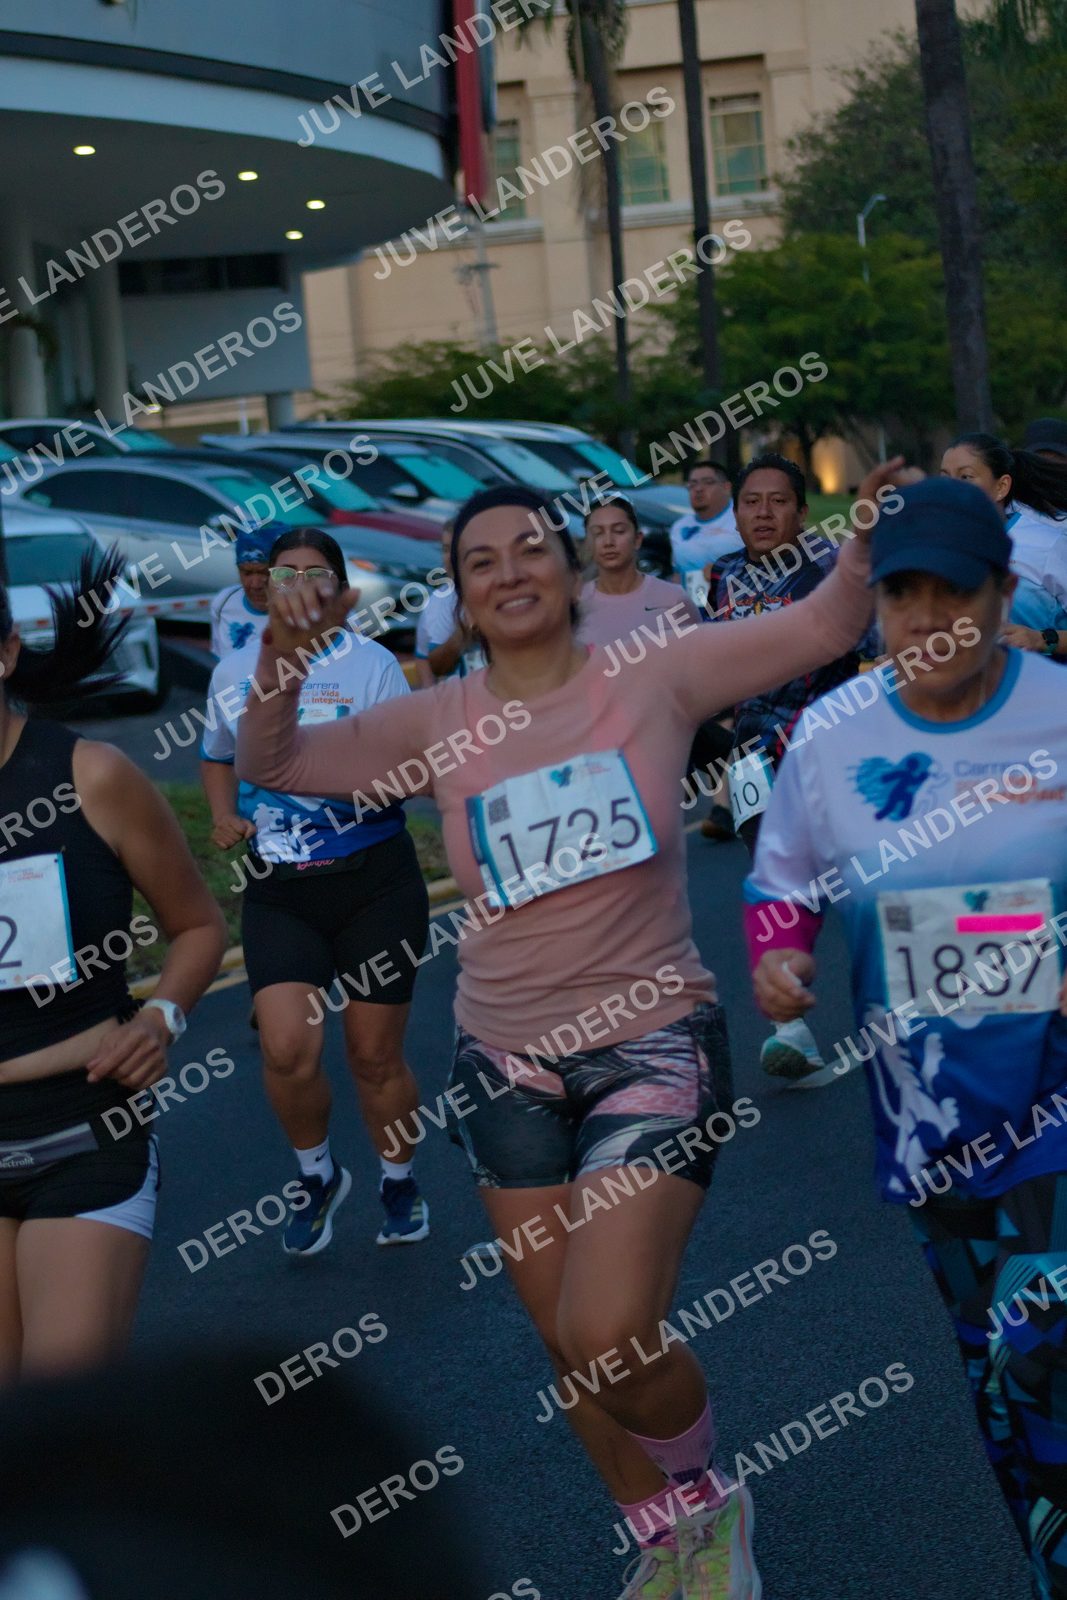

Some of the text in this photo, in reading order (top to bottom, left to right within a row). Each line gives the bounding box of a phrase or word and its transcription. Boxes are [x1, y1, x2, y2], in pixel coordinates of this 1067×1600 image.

[733, 781, 760, 815] 10
[499, 797, 641, 882] 1725
[897, 940, 1050, 999] 1837
